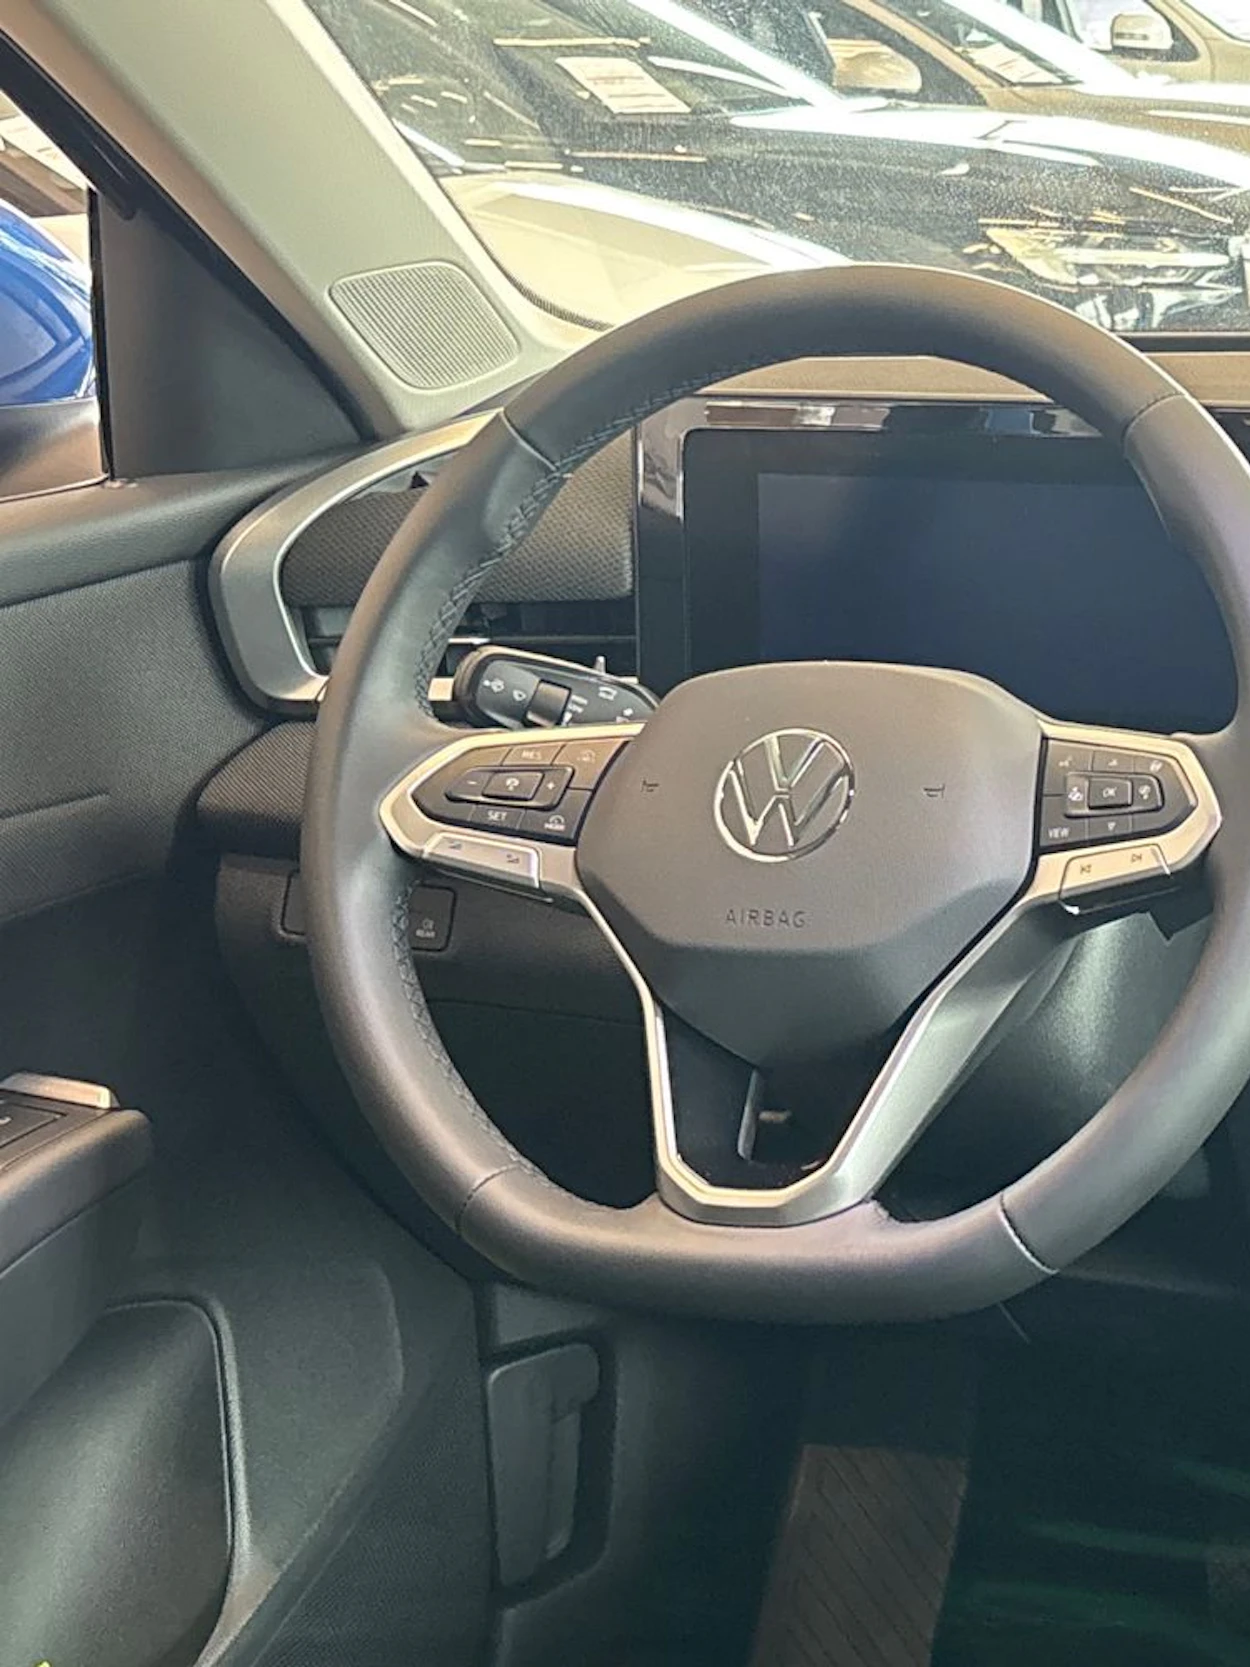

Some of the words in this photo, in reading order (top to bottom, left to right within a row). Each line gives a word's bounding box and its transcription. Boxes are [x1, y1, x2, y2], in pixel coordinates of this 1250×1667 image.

[1102, 786, 1117, 798] OK
[487, 809, 508, 821] SET
[1048, 827, 1070, 838] VIEW
[725, 908, 806, 929] AIRBAG
